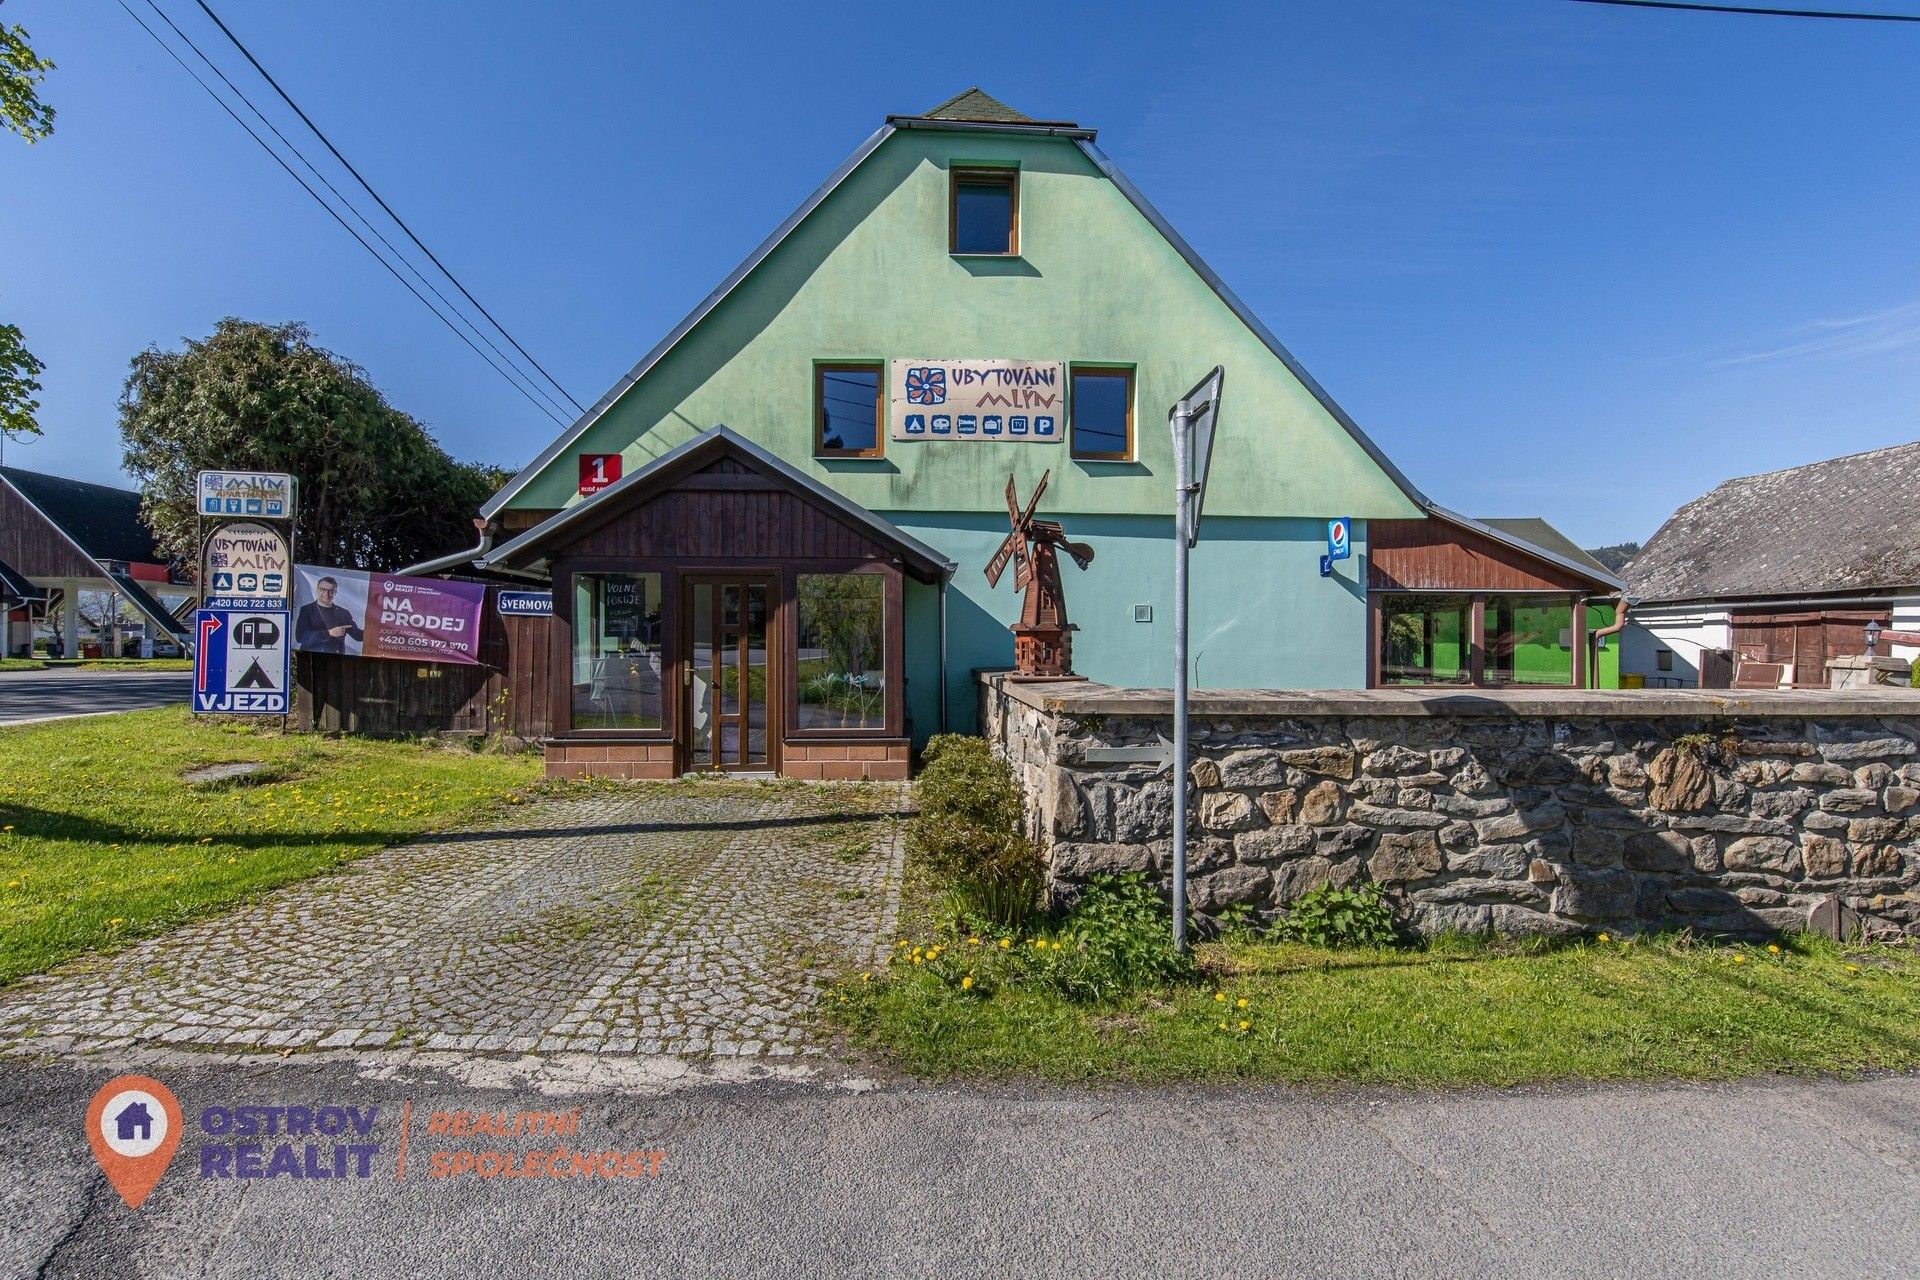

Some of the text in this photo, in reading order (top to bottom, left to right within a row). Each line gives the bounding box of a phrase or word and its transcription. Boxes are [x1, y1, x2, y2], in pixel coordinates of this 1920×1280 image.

[952, 367, 1057, 387] UBYTOVÁNÍ
[976, 386, 1056, 410] MLÝN
[592, 457, 608, 483] 1
[268, 502, 279, 511] TV
[214, 538, 278, 553] UBYTOVÁNÍ
[230, 553, 286, 570] MLÝN
[210, 599, 282, 608] +420 602 722 833
[383, 596, 413, 612] NA
[380, 611, 465, 632] PRODEJ
[379, 636, 405, 645] +420
[407, 637, 428, 647] 605
[198, 693, 285, 711] VJEZD
